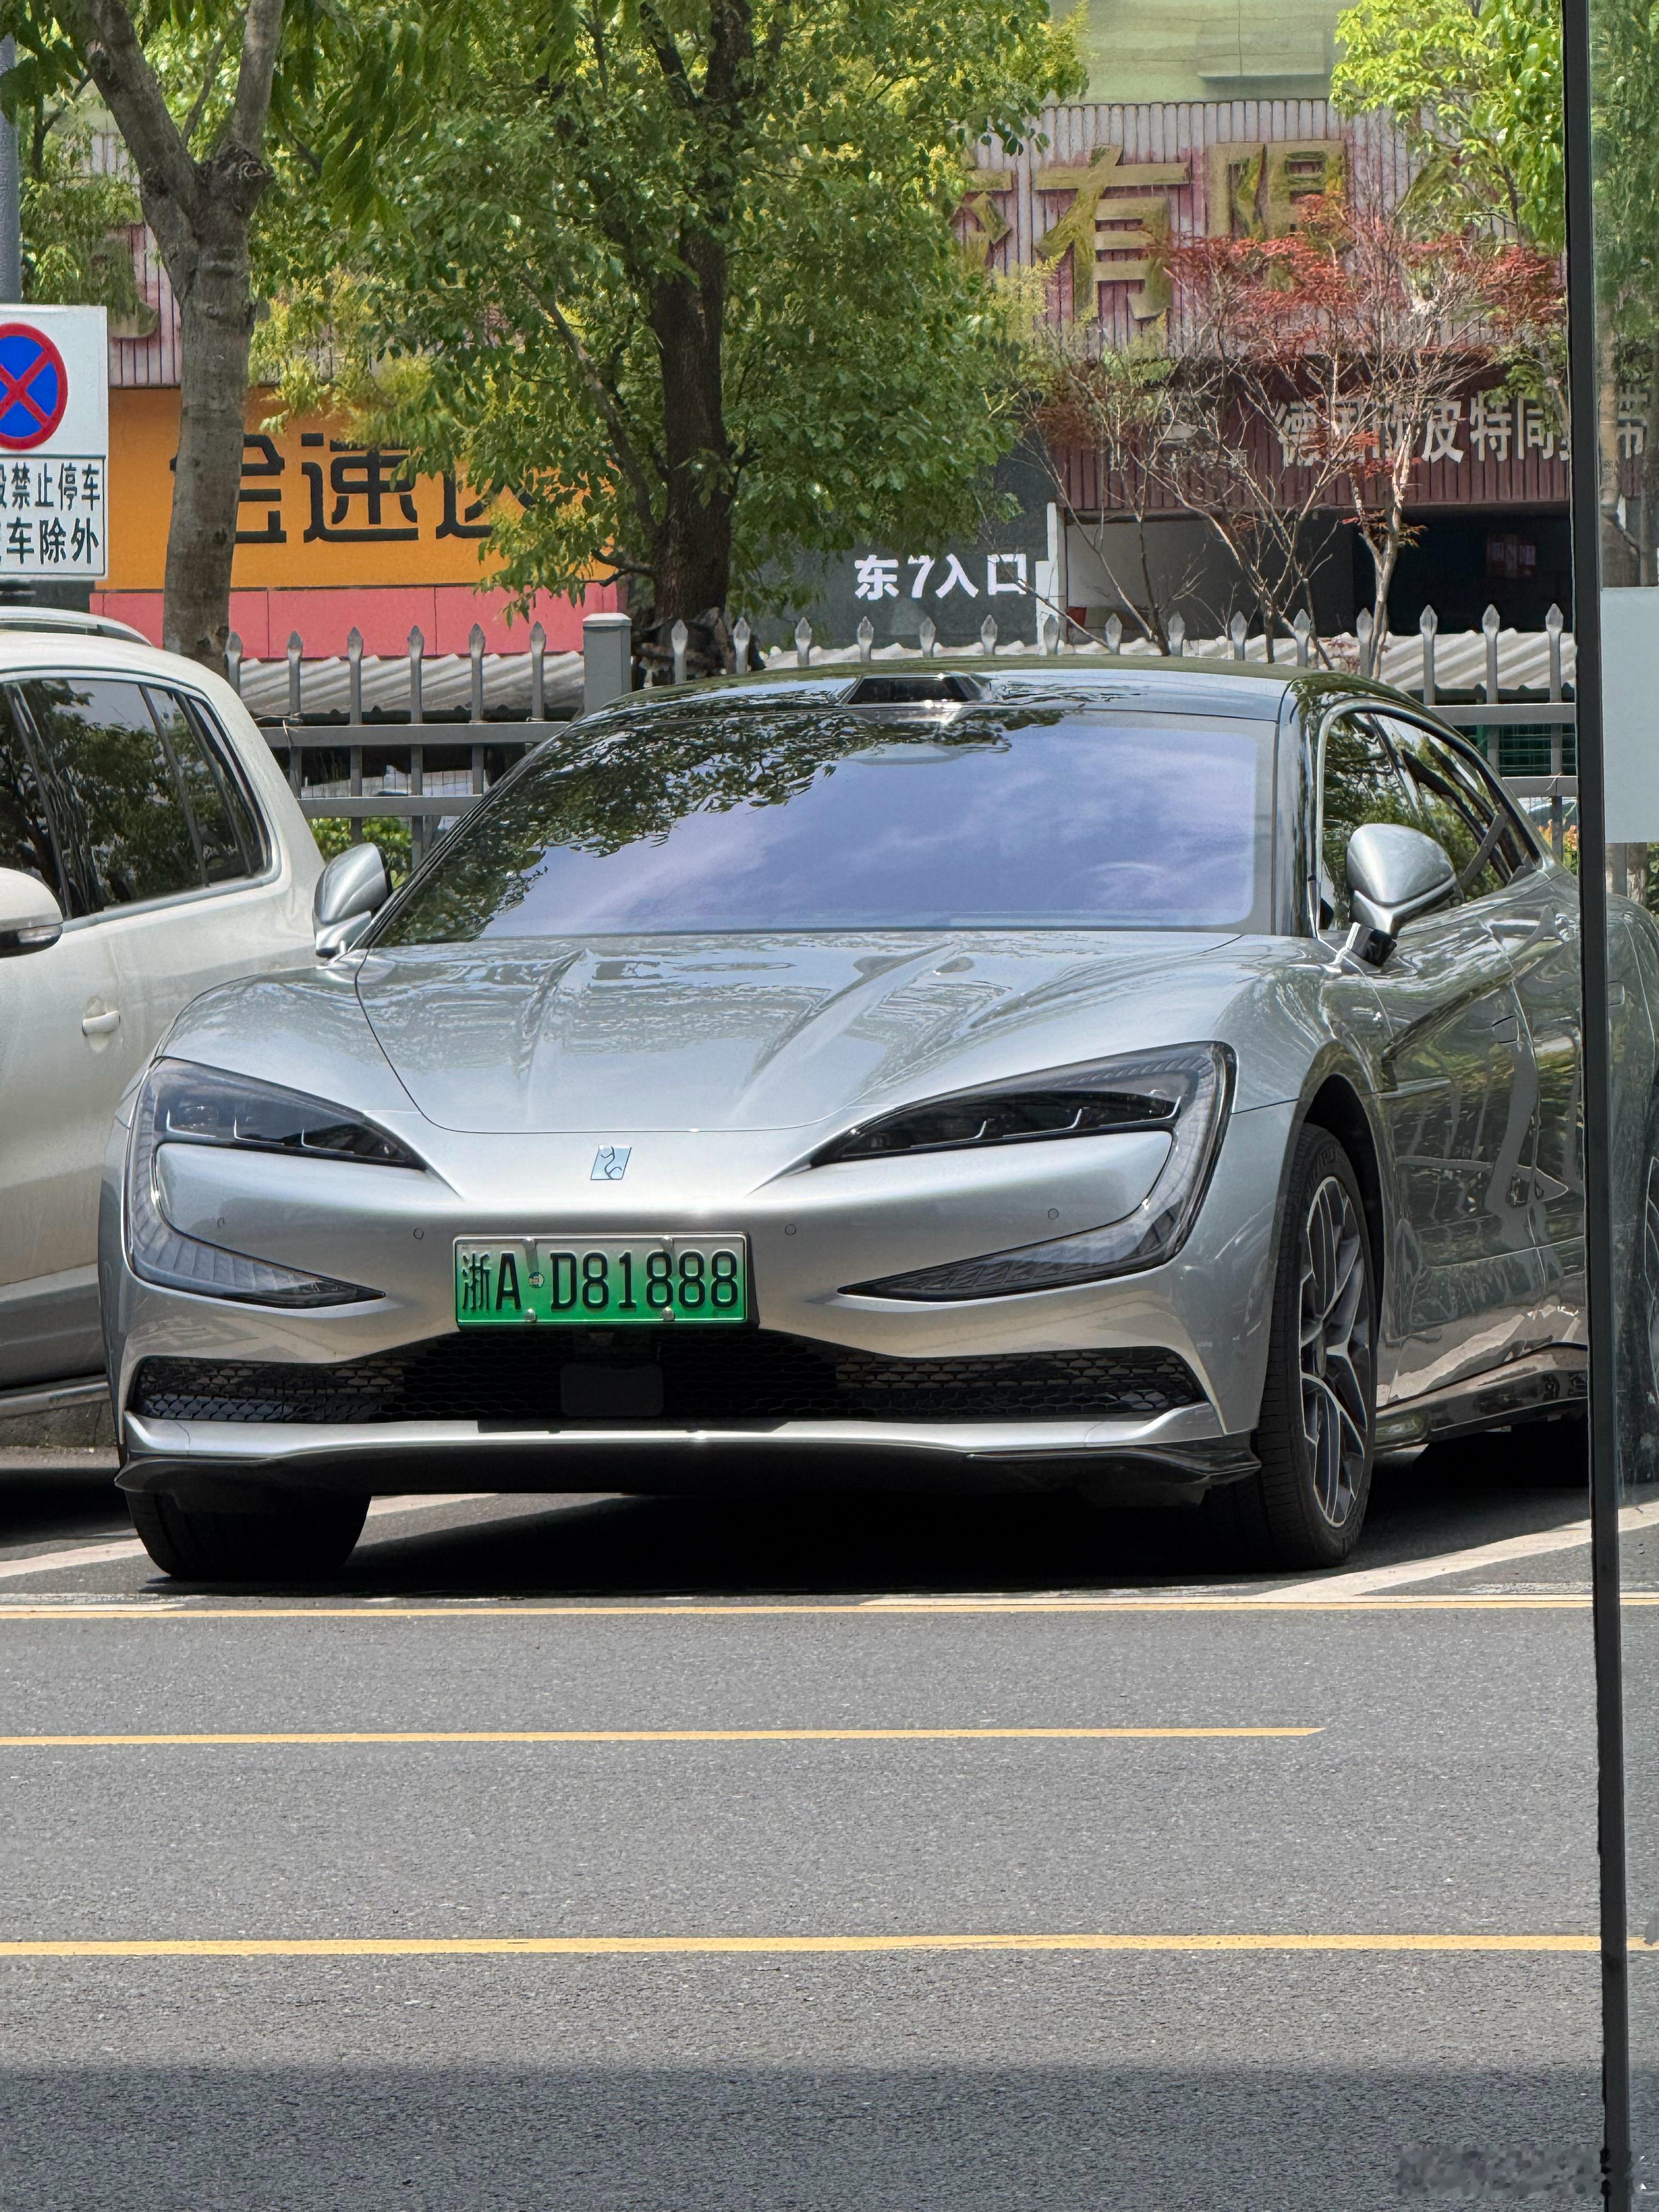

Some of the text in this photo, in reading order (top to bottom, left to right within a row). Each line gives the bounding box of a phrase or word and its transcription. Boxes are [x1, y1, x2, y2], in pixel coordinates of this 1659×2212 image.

[0, 517, 99, 565] 车除外
[854, 554, 1027, 600] 东7入口
